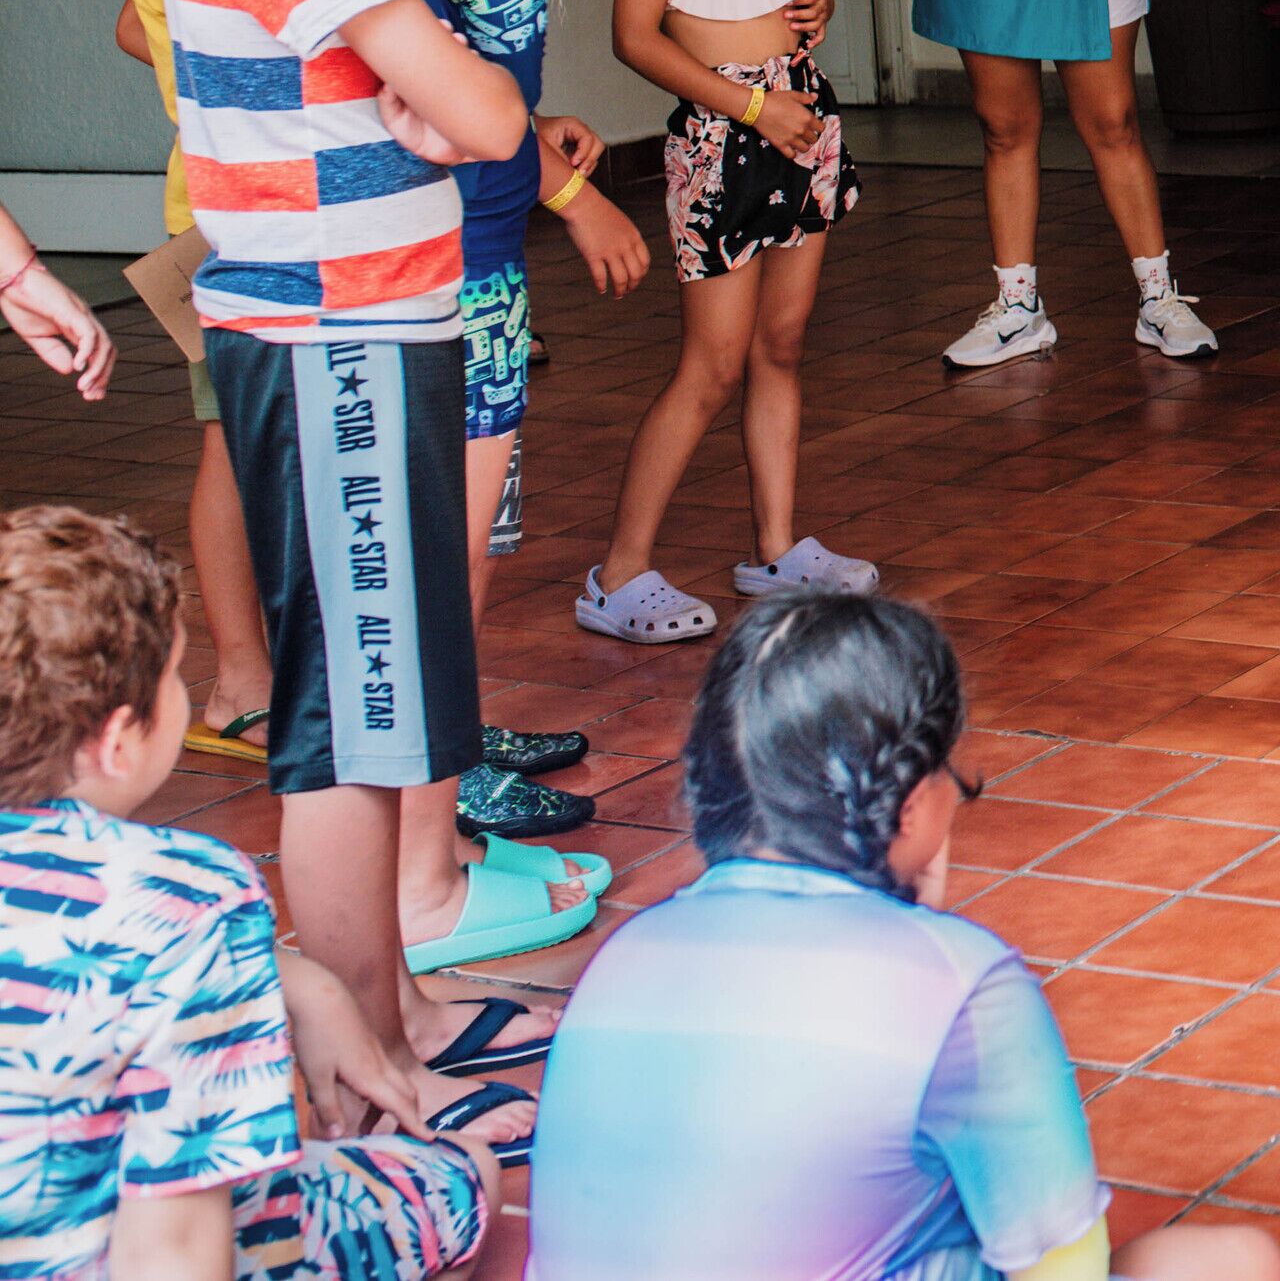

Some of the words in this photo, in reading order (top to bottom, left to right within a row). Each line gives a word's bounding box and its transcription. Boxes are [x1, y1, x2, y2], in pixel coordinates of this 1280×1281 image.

[332, 399, 376, 454] STAR
[340, 475, 382, 512] ALL
[350, 541, 388, 592] STAR
[356, 614, 392, 651] ALL
[363, 681, 395, 732] STAR
